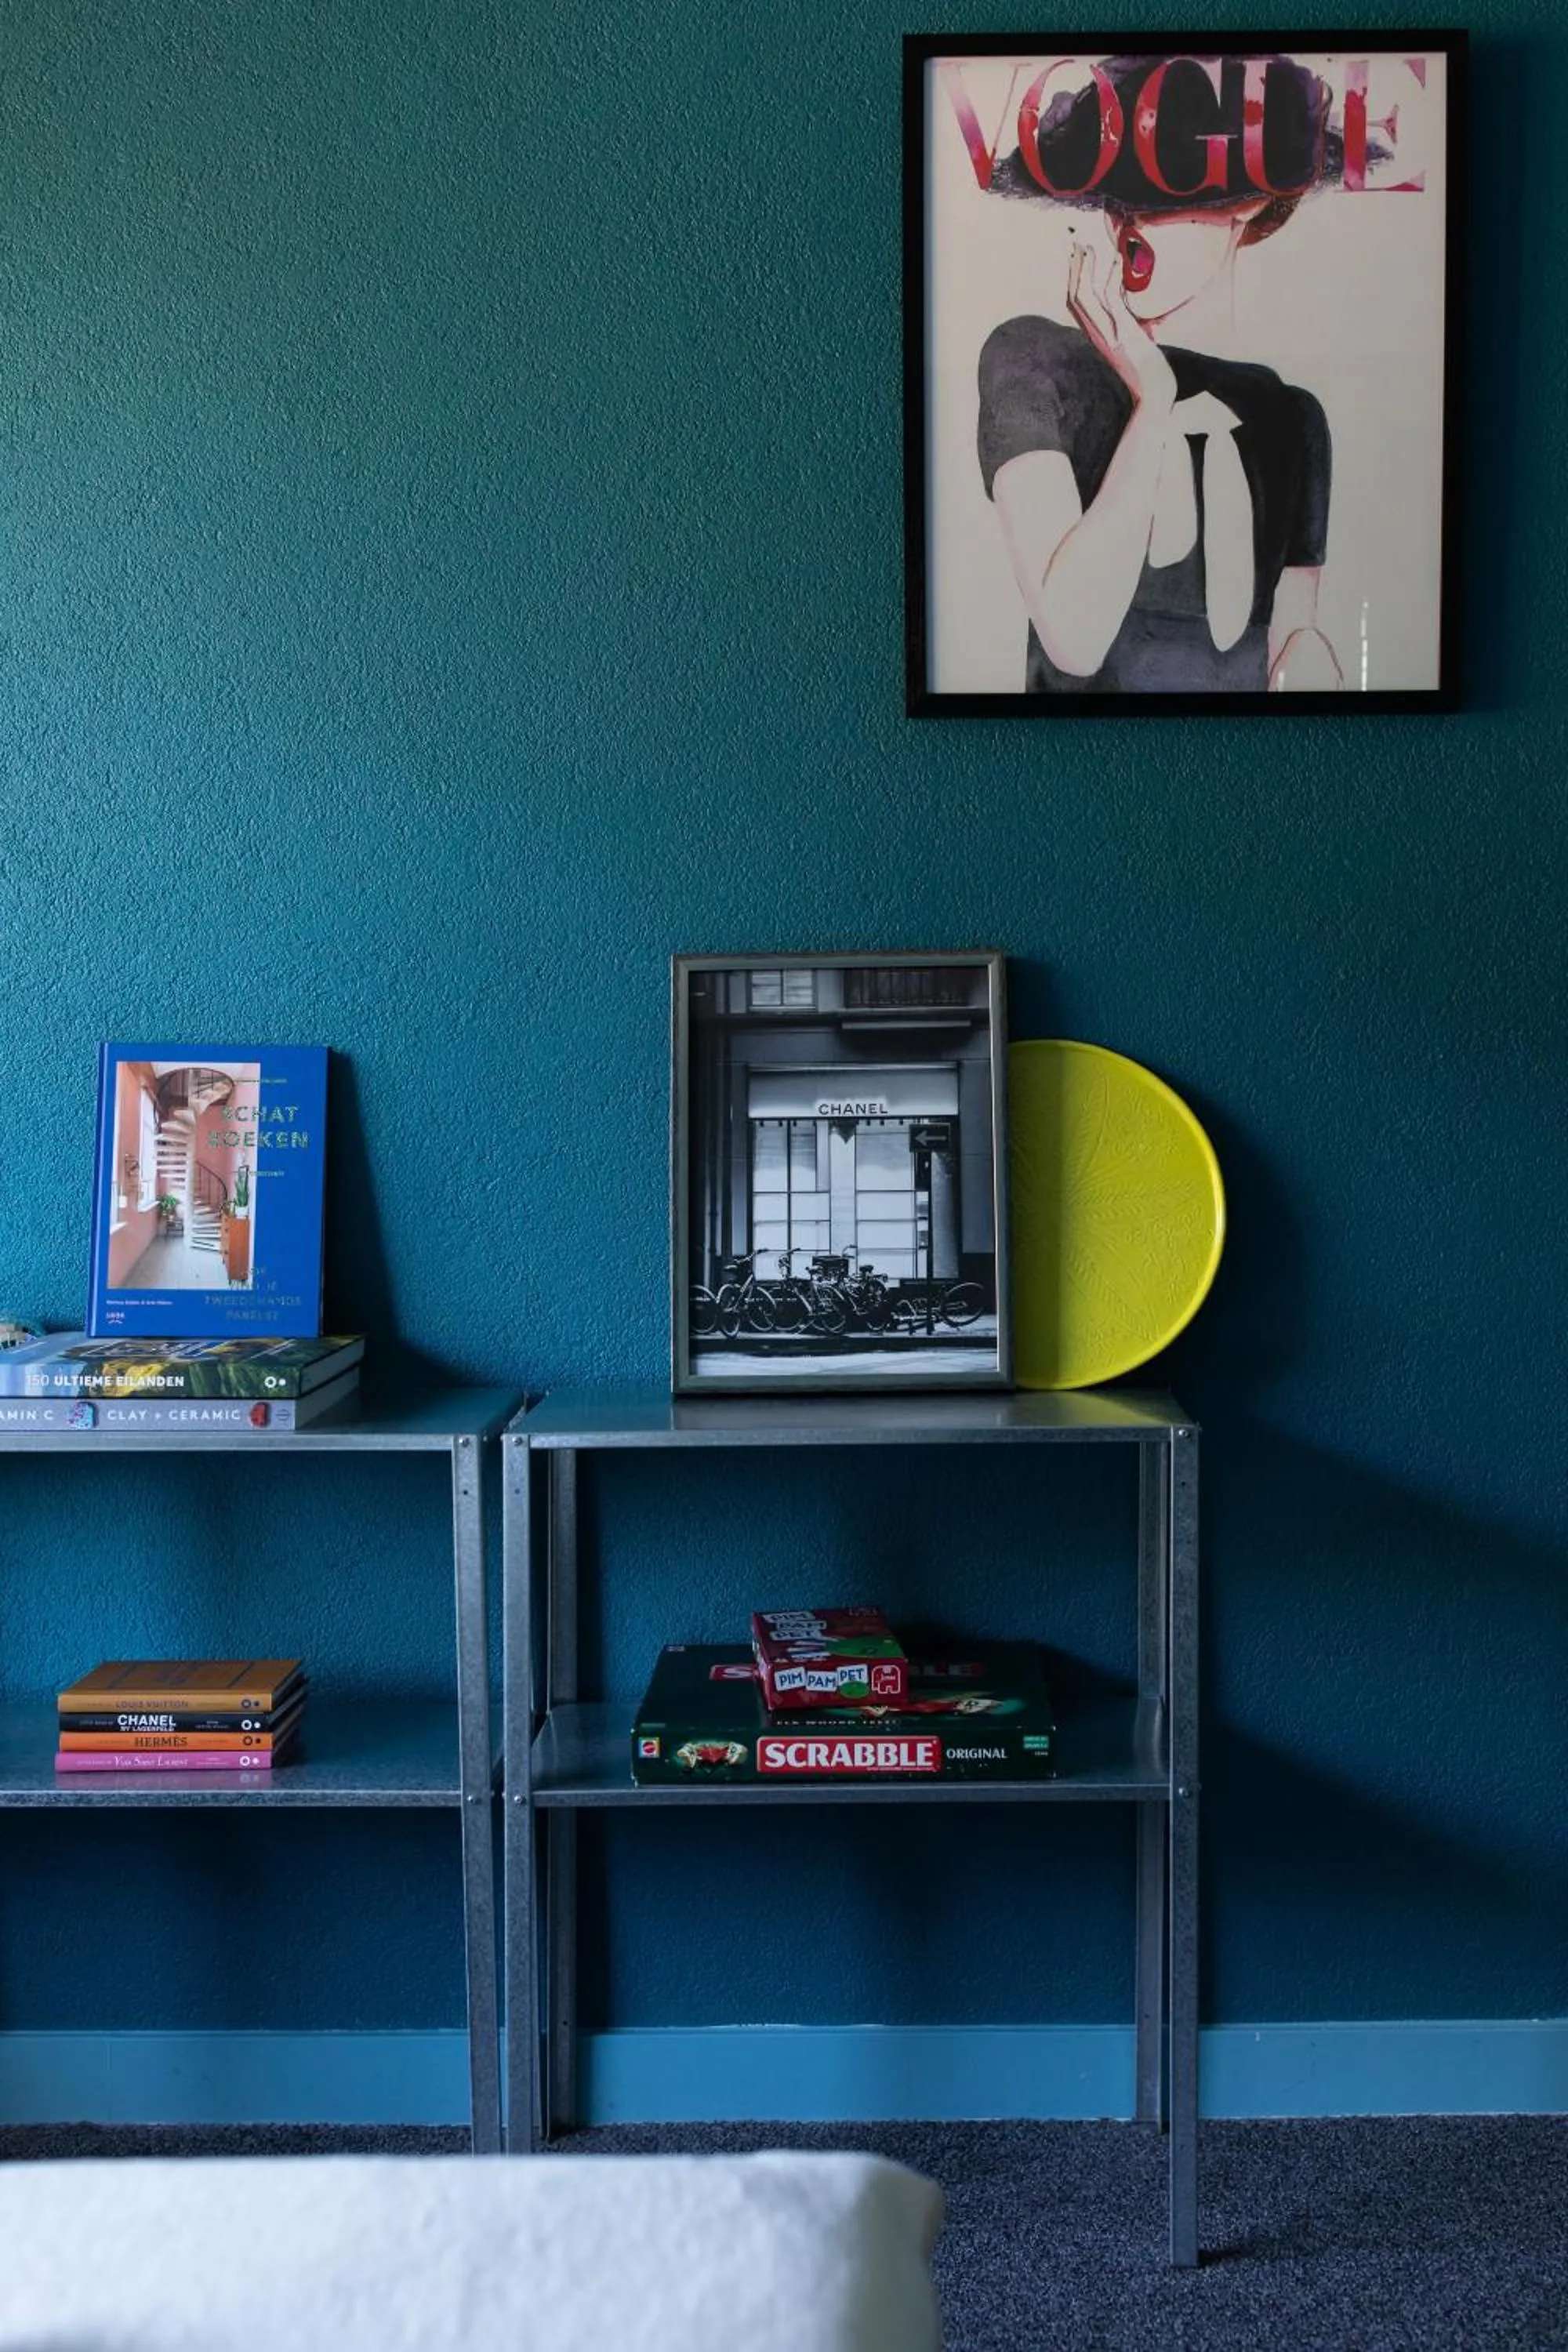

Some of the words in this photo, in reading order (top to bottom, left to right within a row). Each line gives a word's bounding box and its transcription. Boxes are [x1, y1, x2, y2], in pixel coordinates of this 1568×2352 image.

[937, 55, 1427, 197] VOGUE
[222, 1105, 299, 1123] SCHAT
[818, 1102, 889, 1116] CHANEL
[26, 1376, 49, 1387] 150
[54, 1376, 112, 1387] ULTIEME
[116, 1376, 184, 1387] EILANDEN
[43, 1410, 54, 1421] C
[107, 1409, 147, 1421] CLAY
[170, 1409, 241, 1421] CERAMIC
[779, 1672, 803, 1687] PIM
[808, 1675, 836, 1688] PAM
[840, 1668, 865, 1682] PET
[115, 1700, 145, 1709] LOUIS
[147, 1700, 189, 1709] VUITTON
[117, 1714, 176, 1726] CHANEL
[764, 1742, 935, 1768] SCRABBLE
[946, 1747, 1008, 1760] ORIGINAL
